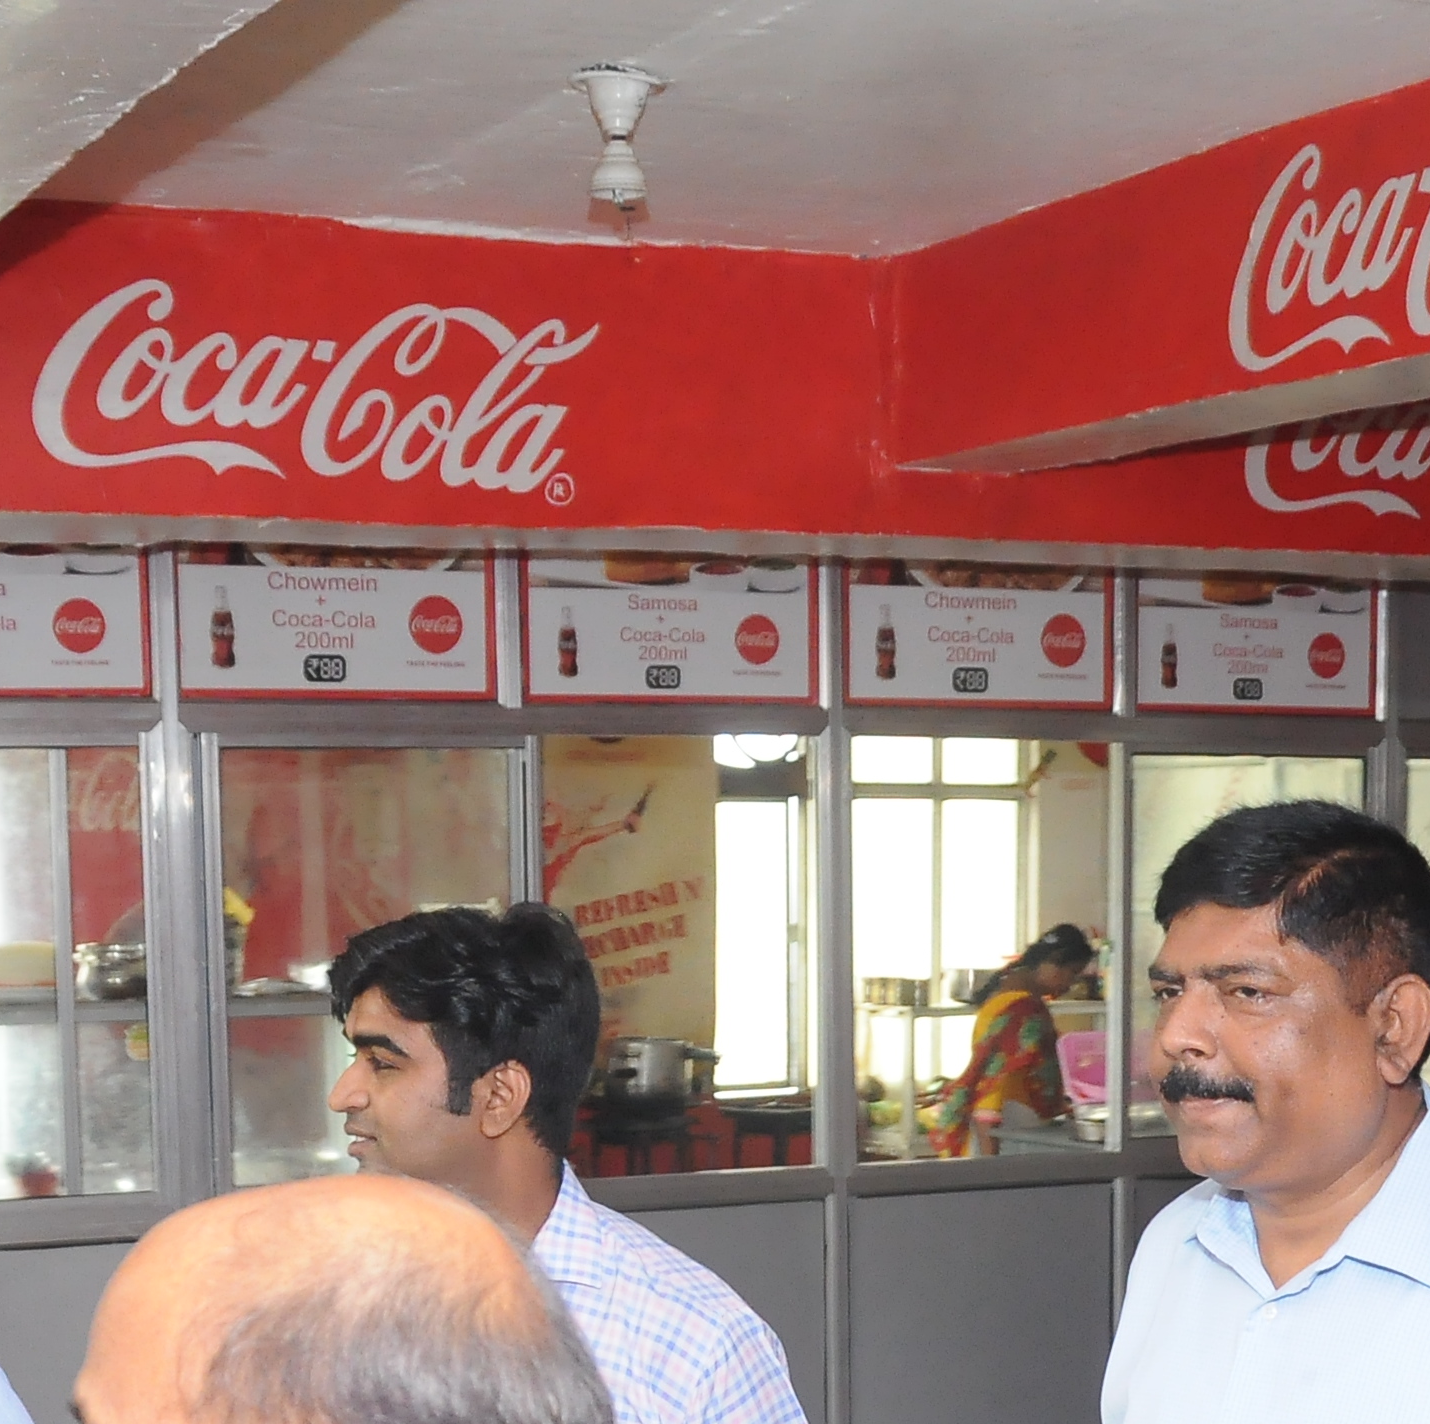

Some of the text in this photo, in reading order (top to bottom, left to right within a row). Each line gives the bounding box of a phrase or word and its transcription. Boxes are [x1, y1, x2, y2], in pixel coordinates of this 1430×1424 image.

[32, 279, 598, 495] Coca-Cola
[267, 571, 378, 592] Chowmein
[628, 594, 698, 611] Samosa
[925, 591, 1017, 610] Chowmein
[272, 609, 376, 629] Coca-Cola
[295, 631, 354, 649] 200ml
[621, 626, 705, 643] Coca-Cola
[928, 626, 1014, 644] Coca-Cola
[638, 646, 688, 661] 200ml
[946, 646, 996, 663] 200ml
[581, 913, 687, 959] ECHARGE
